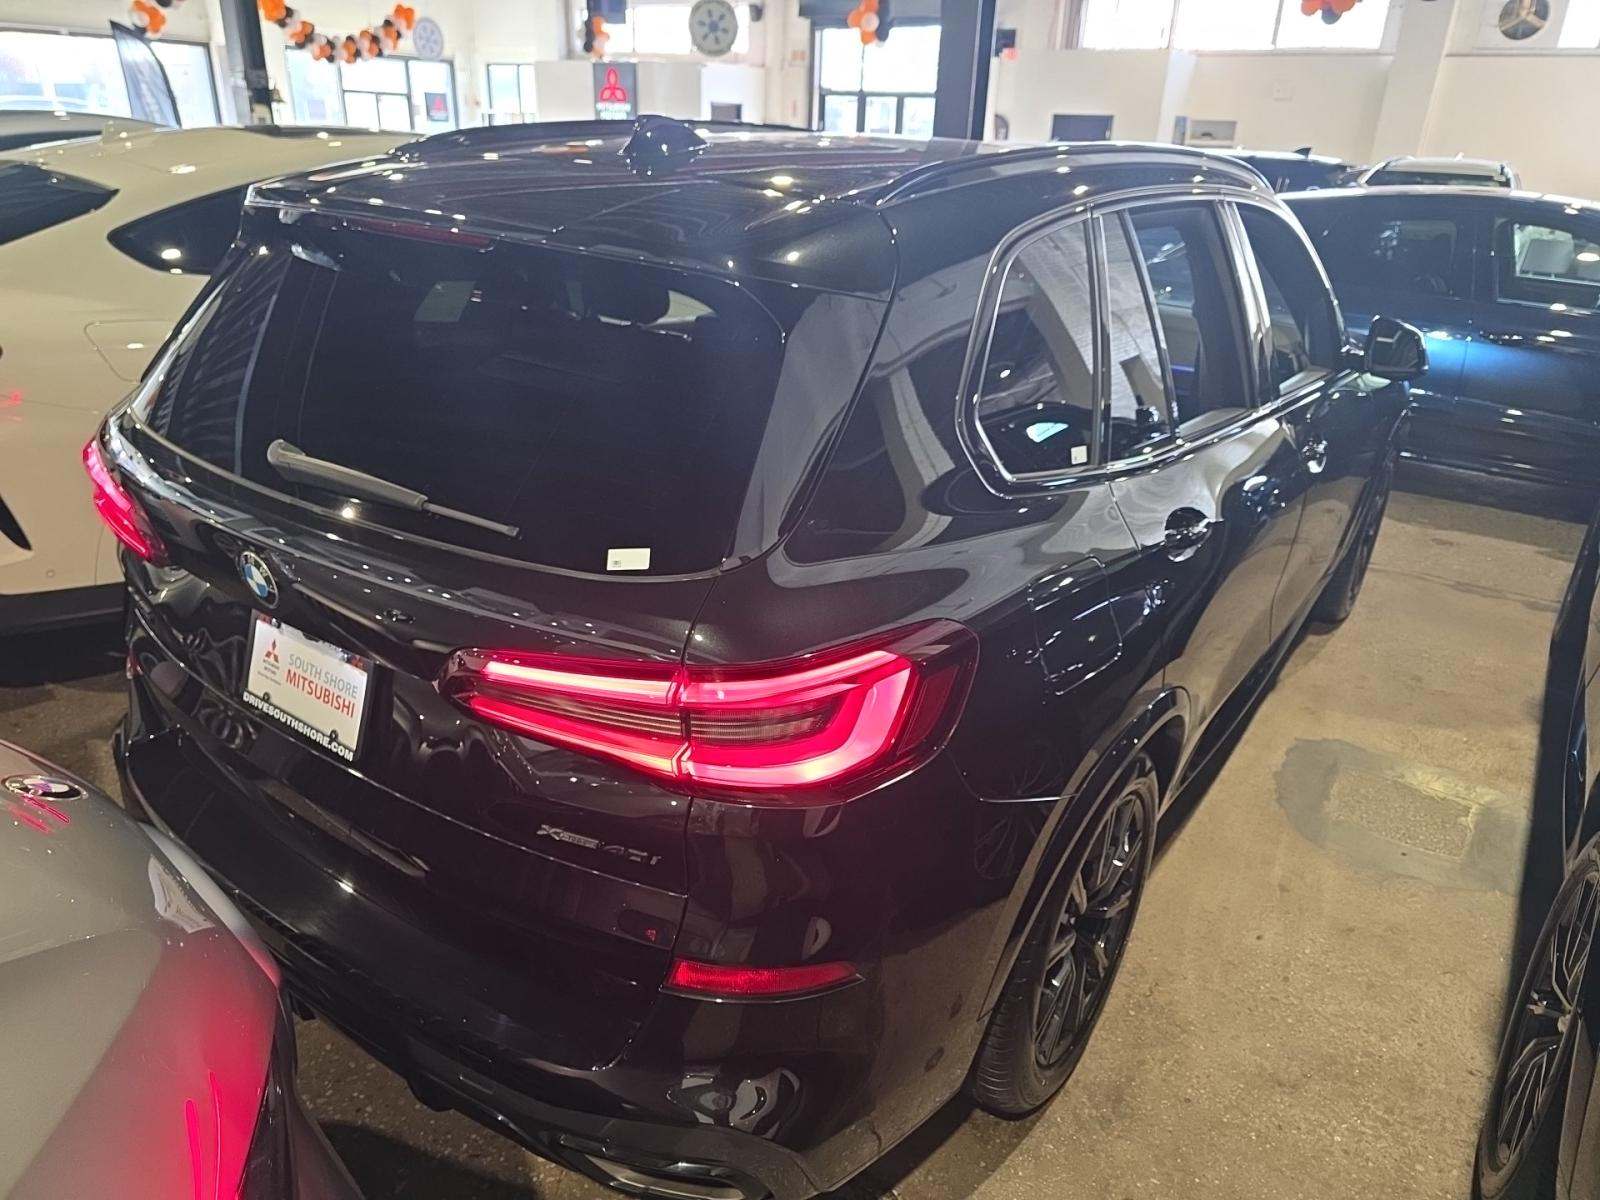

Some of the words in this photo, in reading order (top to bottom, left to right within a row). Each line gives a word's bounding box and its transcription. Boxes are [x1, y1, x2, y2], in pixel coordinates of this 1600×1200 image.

[286, 669, 356, 718] MITSUBISHI
[289, 653, 322, 679] SOUTH
[325, 671, 359, 699] SHORE
[243, 691, 354, 762] DRIVESOUTHSHORE.COM
